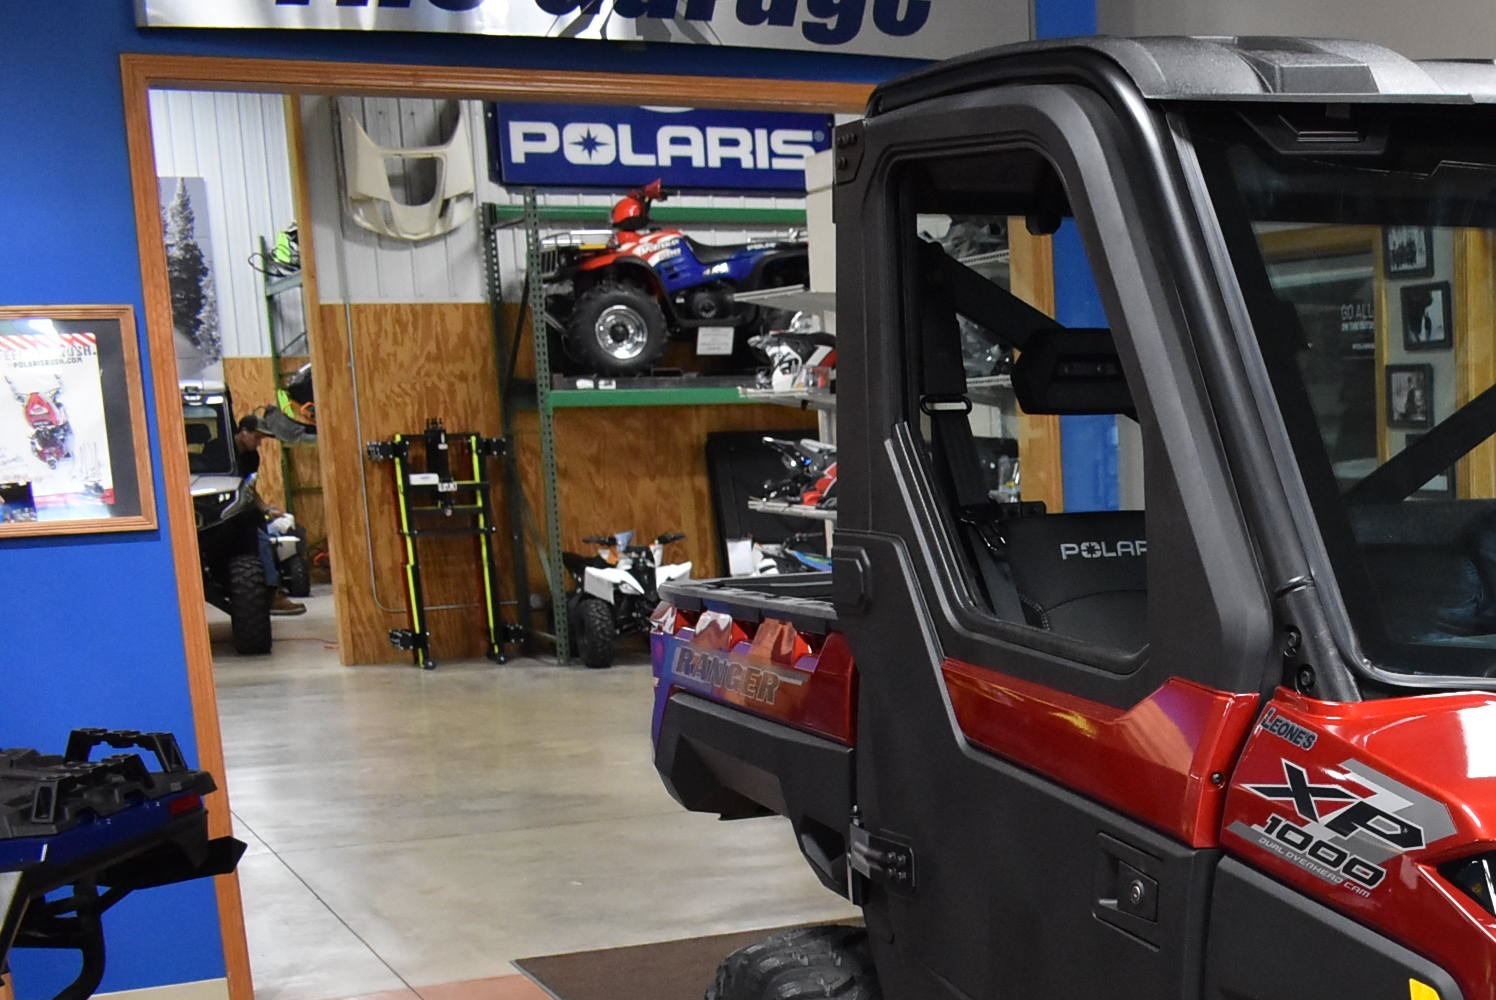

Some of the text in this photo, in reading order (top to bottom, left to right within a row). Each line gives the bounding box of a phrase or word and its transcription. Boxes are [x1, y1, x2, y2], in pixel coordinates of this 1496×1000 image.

[508, 120, 816, 170] POLARIS
[673, 646, 780, 705] RANGER
[1260, 708, 1317, 749] LEONE'S
[1241, 758, 1426, 851] XP
[1259, 837, 1371, 898] DUAL OVERHEAD CAM
[1263, 813, 1387, 889] 1000
